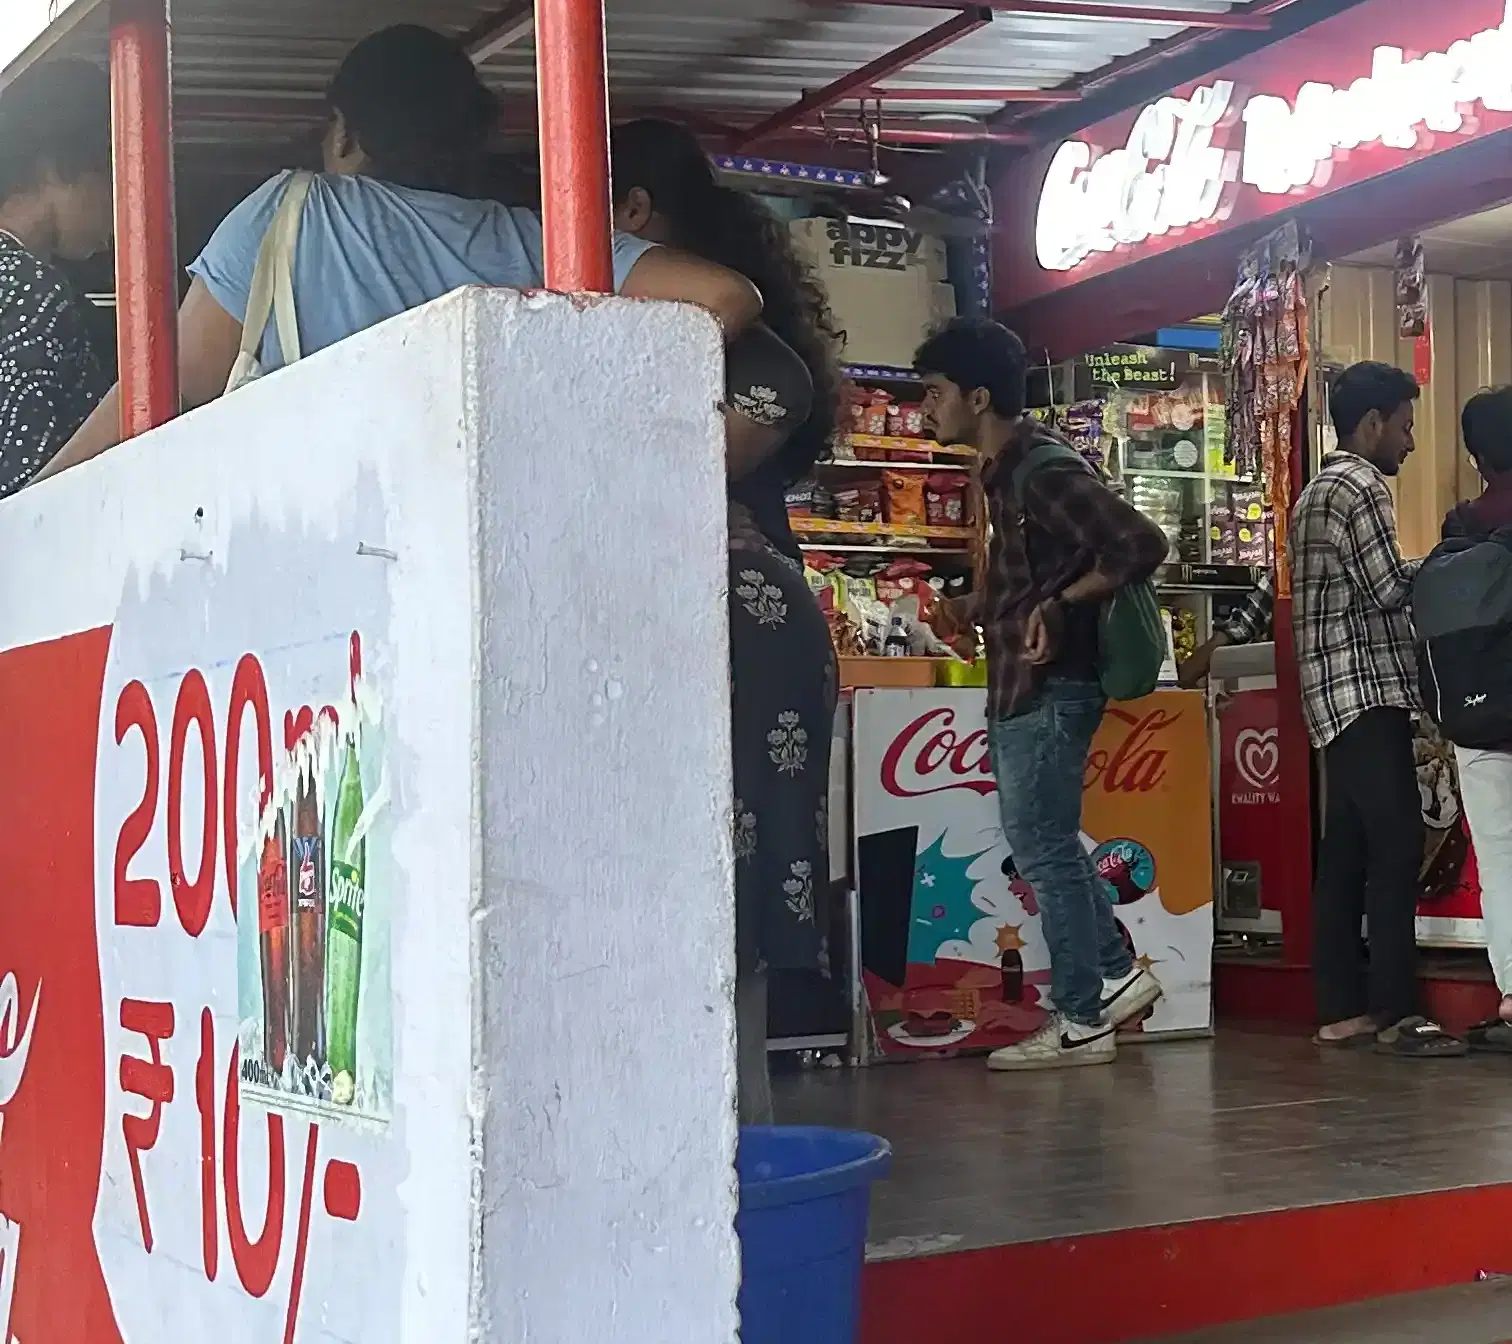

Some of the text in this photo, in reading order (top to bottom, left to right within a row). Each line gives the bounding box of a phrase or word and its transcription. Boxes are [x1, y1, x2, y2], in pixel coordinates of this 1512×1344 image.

[826, 220, 924, 254] appy
[829, 241, 907, 271] fizz
[1084, 351, 1148, 367] Unleash
[1092, 361, 1175, 382] the Beast!
[114, 630, 362, 939] 200
[1231, 793, 1265, 804] KWALITY
[329, 865, 365, 917] Sprite
